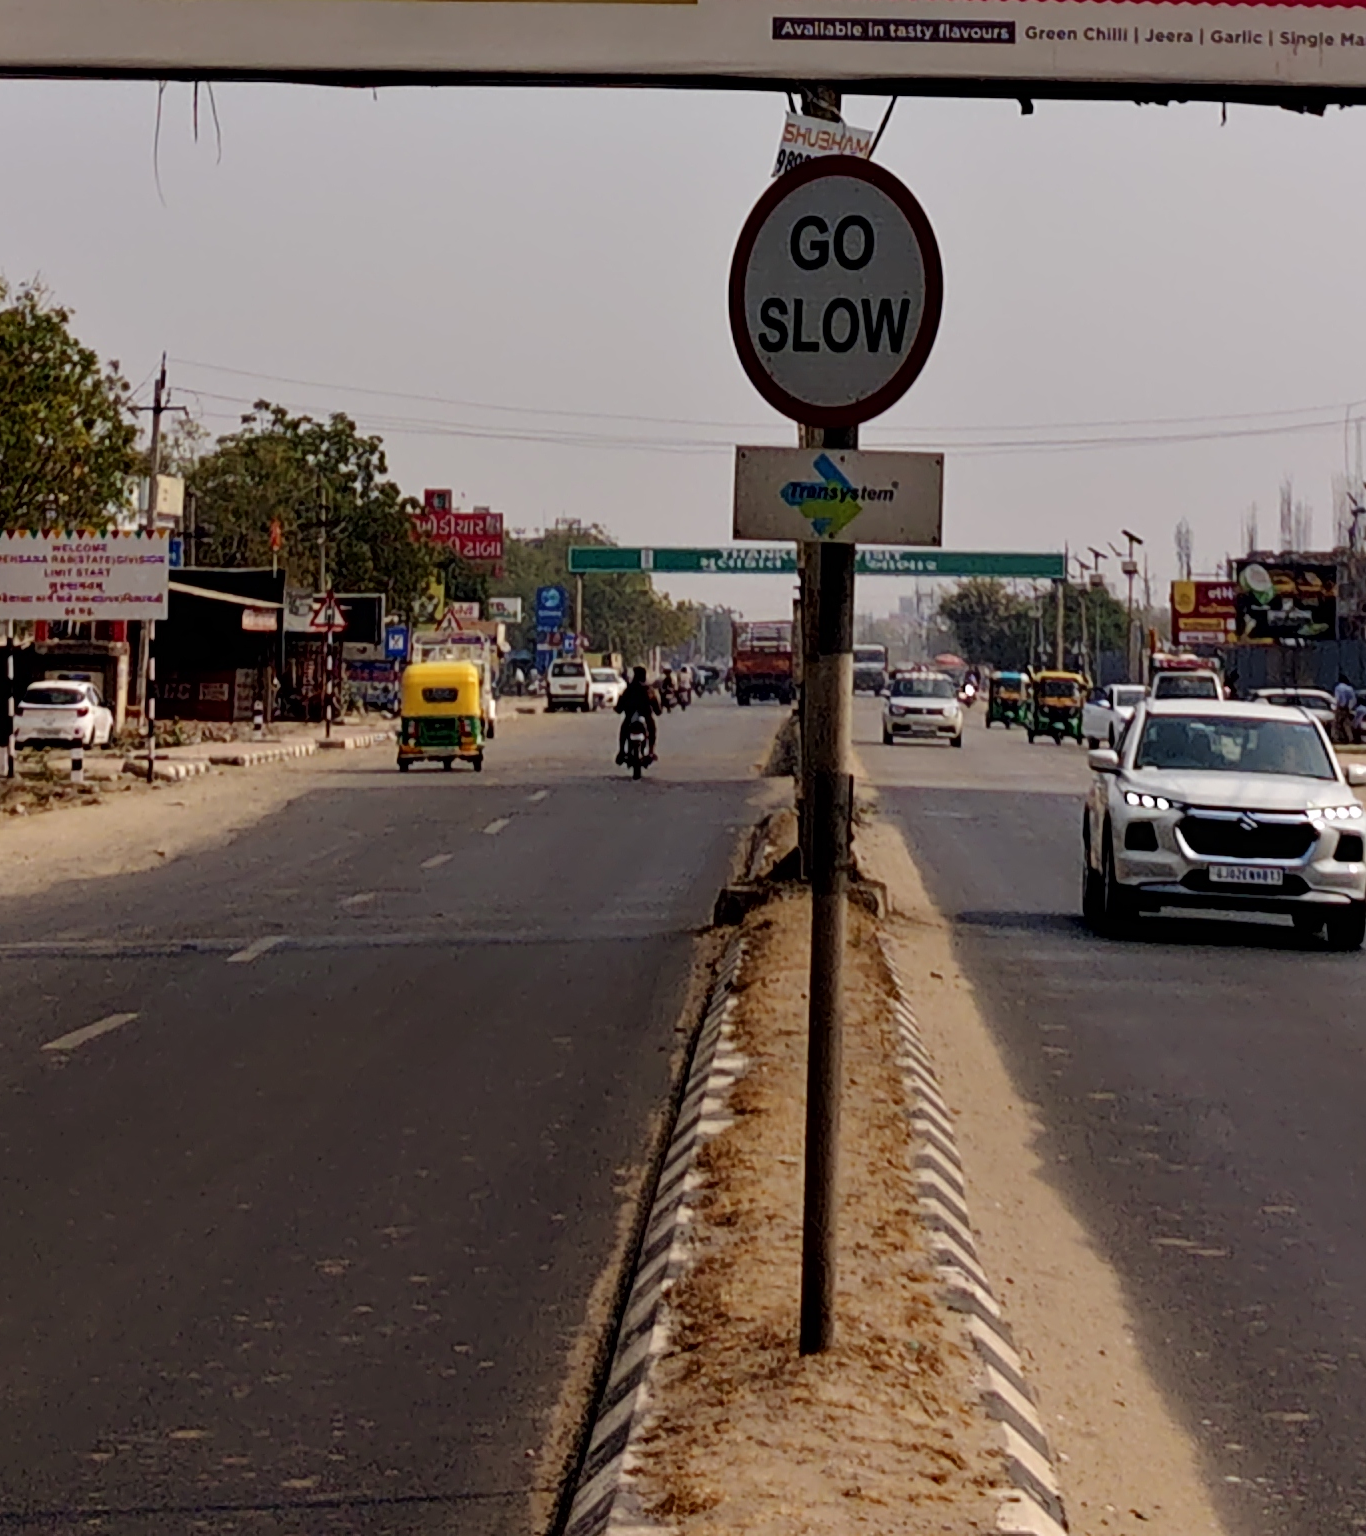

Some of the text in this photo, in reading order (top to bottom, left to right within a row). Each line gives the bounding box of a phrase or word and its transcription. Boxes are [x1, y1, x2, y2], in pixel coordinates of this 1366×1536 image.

[781, 21, 1010, 43] Available in tasty flavours
[1025, 25, 1078, 43] Green
[1084, 26, 1128, 44] Chilli
[1145, 28, 1193, 45] Jeera
[1210, 29, 1262, 47] Garlic
[1280, 30, 1333, 52] Single
[783, 122, 870, 155] SHUBHAM
[790, 215, 874, 270] GO
[759, 298, 910, 354] SLOW
[788, 482, 895, 503] Transystem
[52, 544, 107, 552] WELCOME
